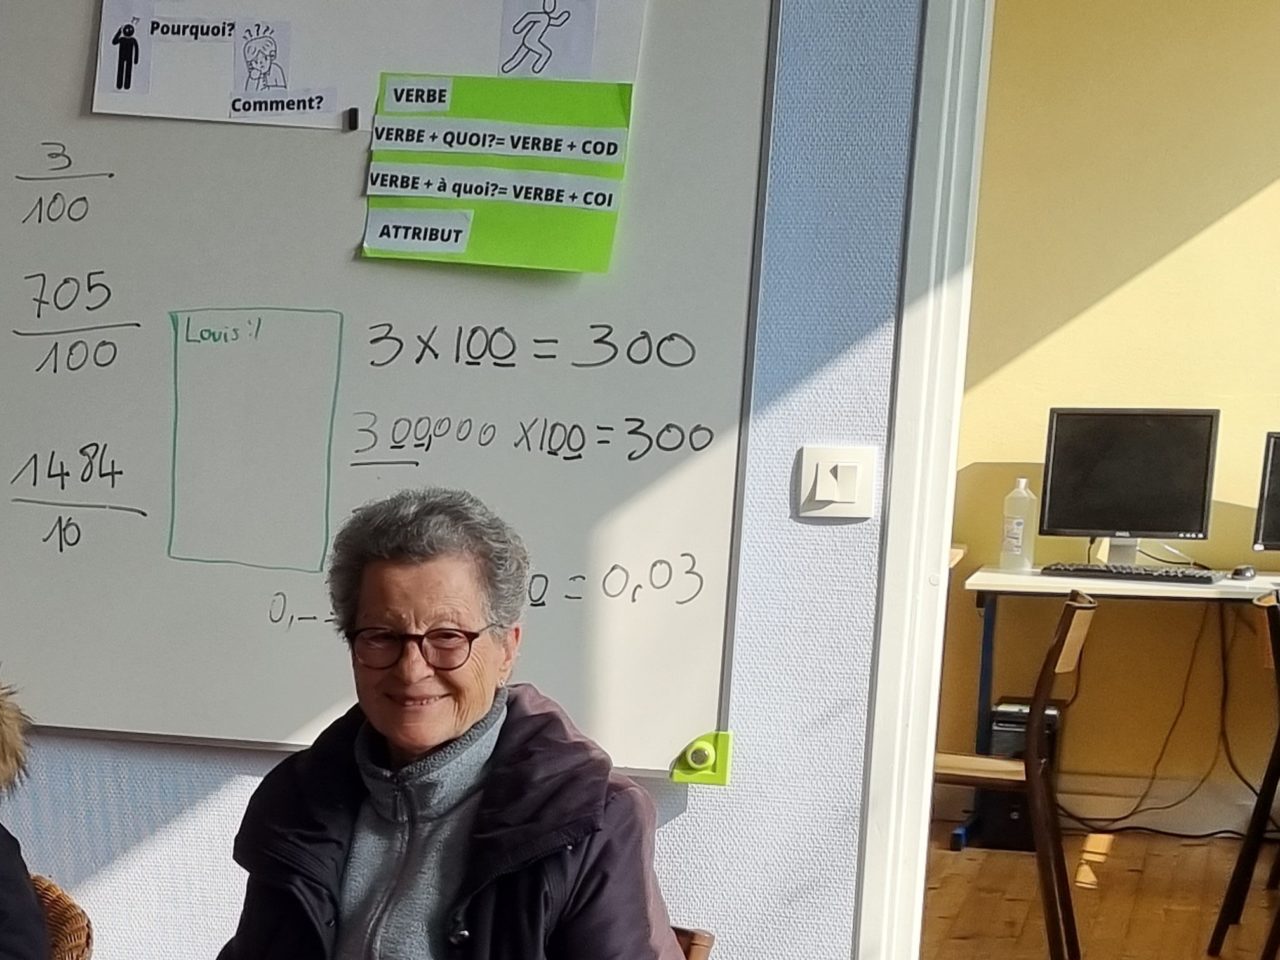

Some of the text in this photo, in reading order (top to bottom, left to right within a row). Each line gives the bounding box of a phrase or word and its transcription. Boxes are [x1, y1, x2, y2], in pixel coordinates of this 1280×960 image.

[149, 20, 236, 41] Pourquoi?
[231, 95, 324, 113] Comment?
[393, 87, 448, 104] VERBE
[40, 141, 73, 172] 3
[374, 126, 426, 144] VERBE
[509, 134, 564, 153] VERBE
[581, 139, 619, 156] COD
[369, 171, 421, 191] VERBE
[436, 176, 448, 193] à
[512, 184, 566, 204] VERBE
[581, 191, 614, 210] COI
[21, 192, 89, 224] 100
[378, 224, 464, 244] ATTRIBUT
[23, 270, 112, 319] 705
[35, 339, 118, 374] 100
[368, 322, 404, 367] 3
[454, 325, 517, 368] 100
[571, 324, 696, 368] 300
[624, 417, 715, 462] 300
[601, 552, 704, 605] 0,03
